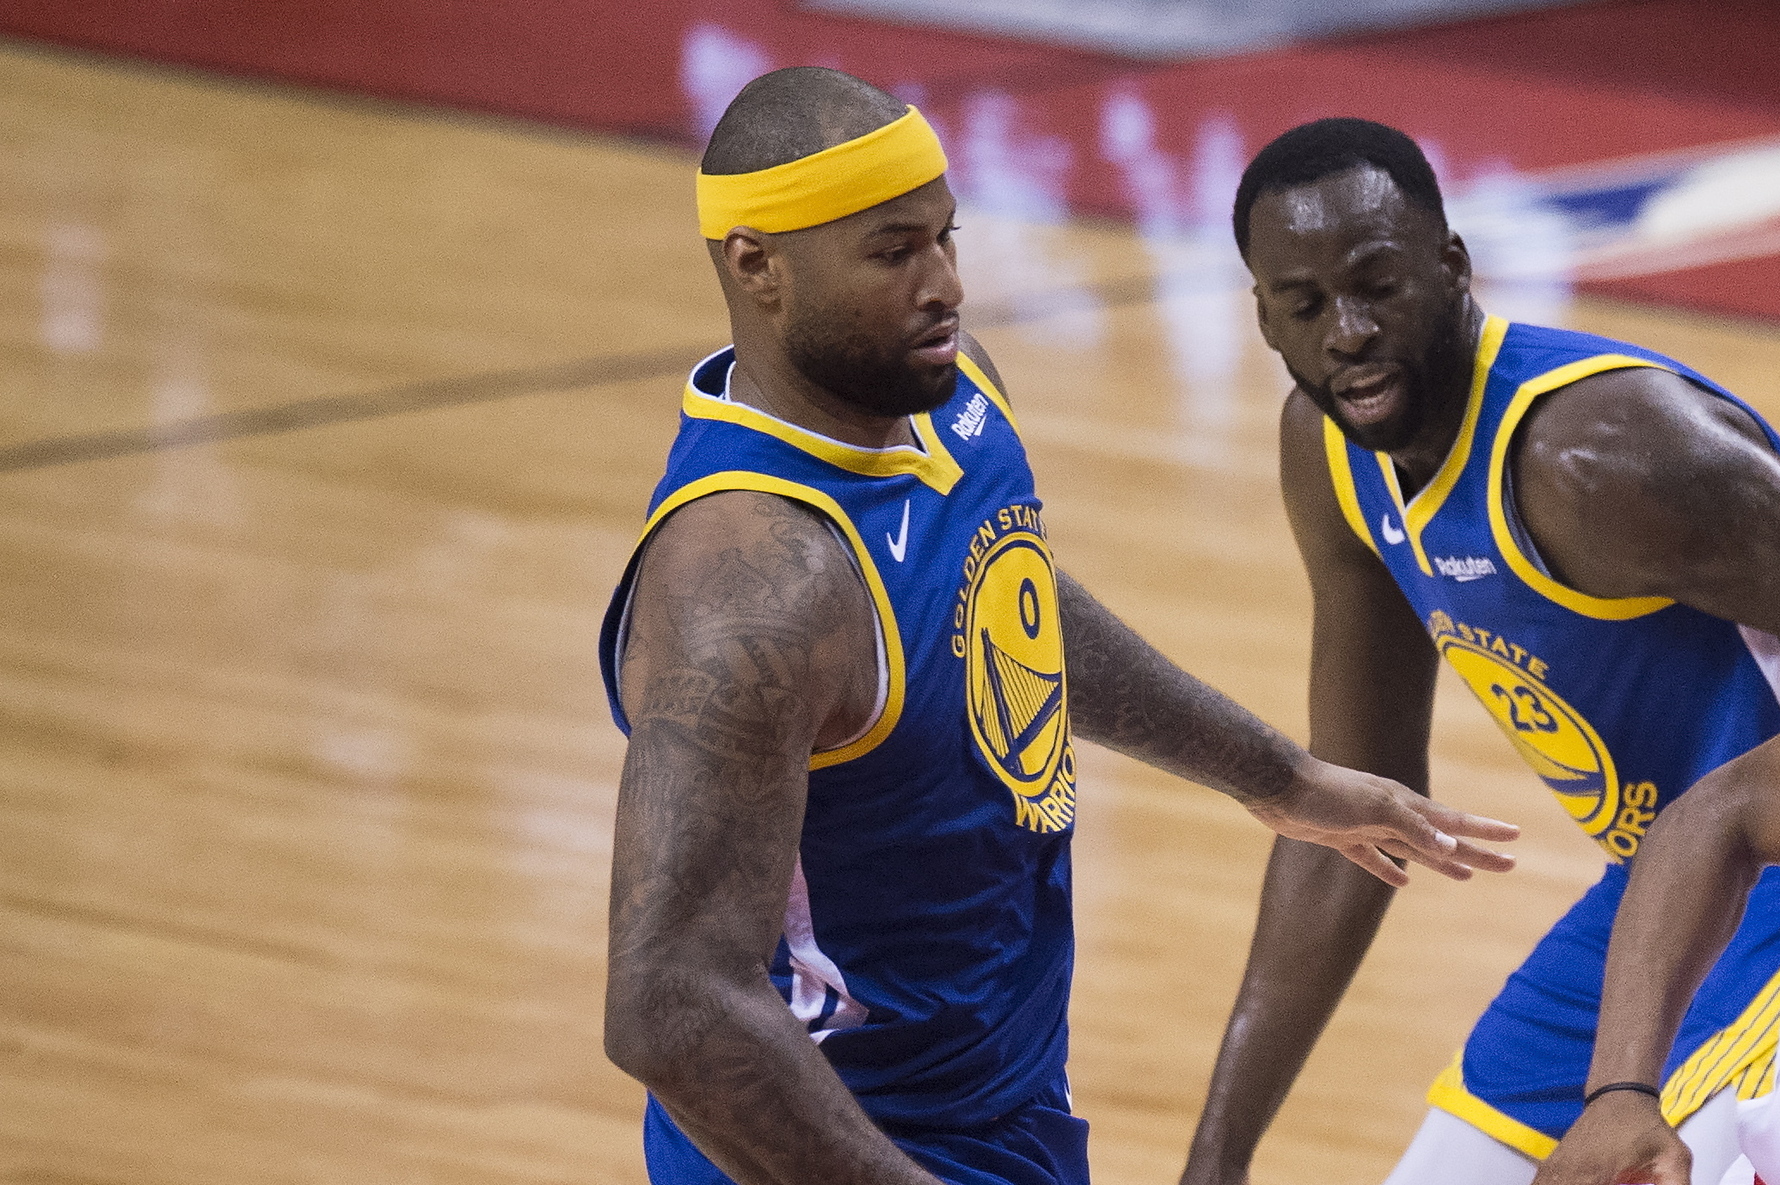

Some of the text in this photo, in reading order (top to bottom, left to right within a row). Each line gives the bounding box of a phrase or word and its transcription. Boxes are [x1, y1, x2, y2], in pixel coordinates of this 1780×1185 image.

[951, 393, 989, 440] Rakuten
[952, 519, 997, 659] GOLDEN
[1018, 577, 1041, 640] 0
[1457, 622, 1550, 680] STATE
[1490, 683, 1559, 734] 23
[1012, 732, 1077, 834] WARRIO
